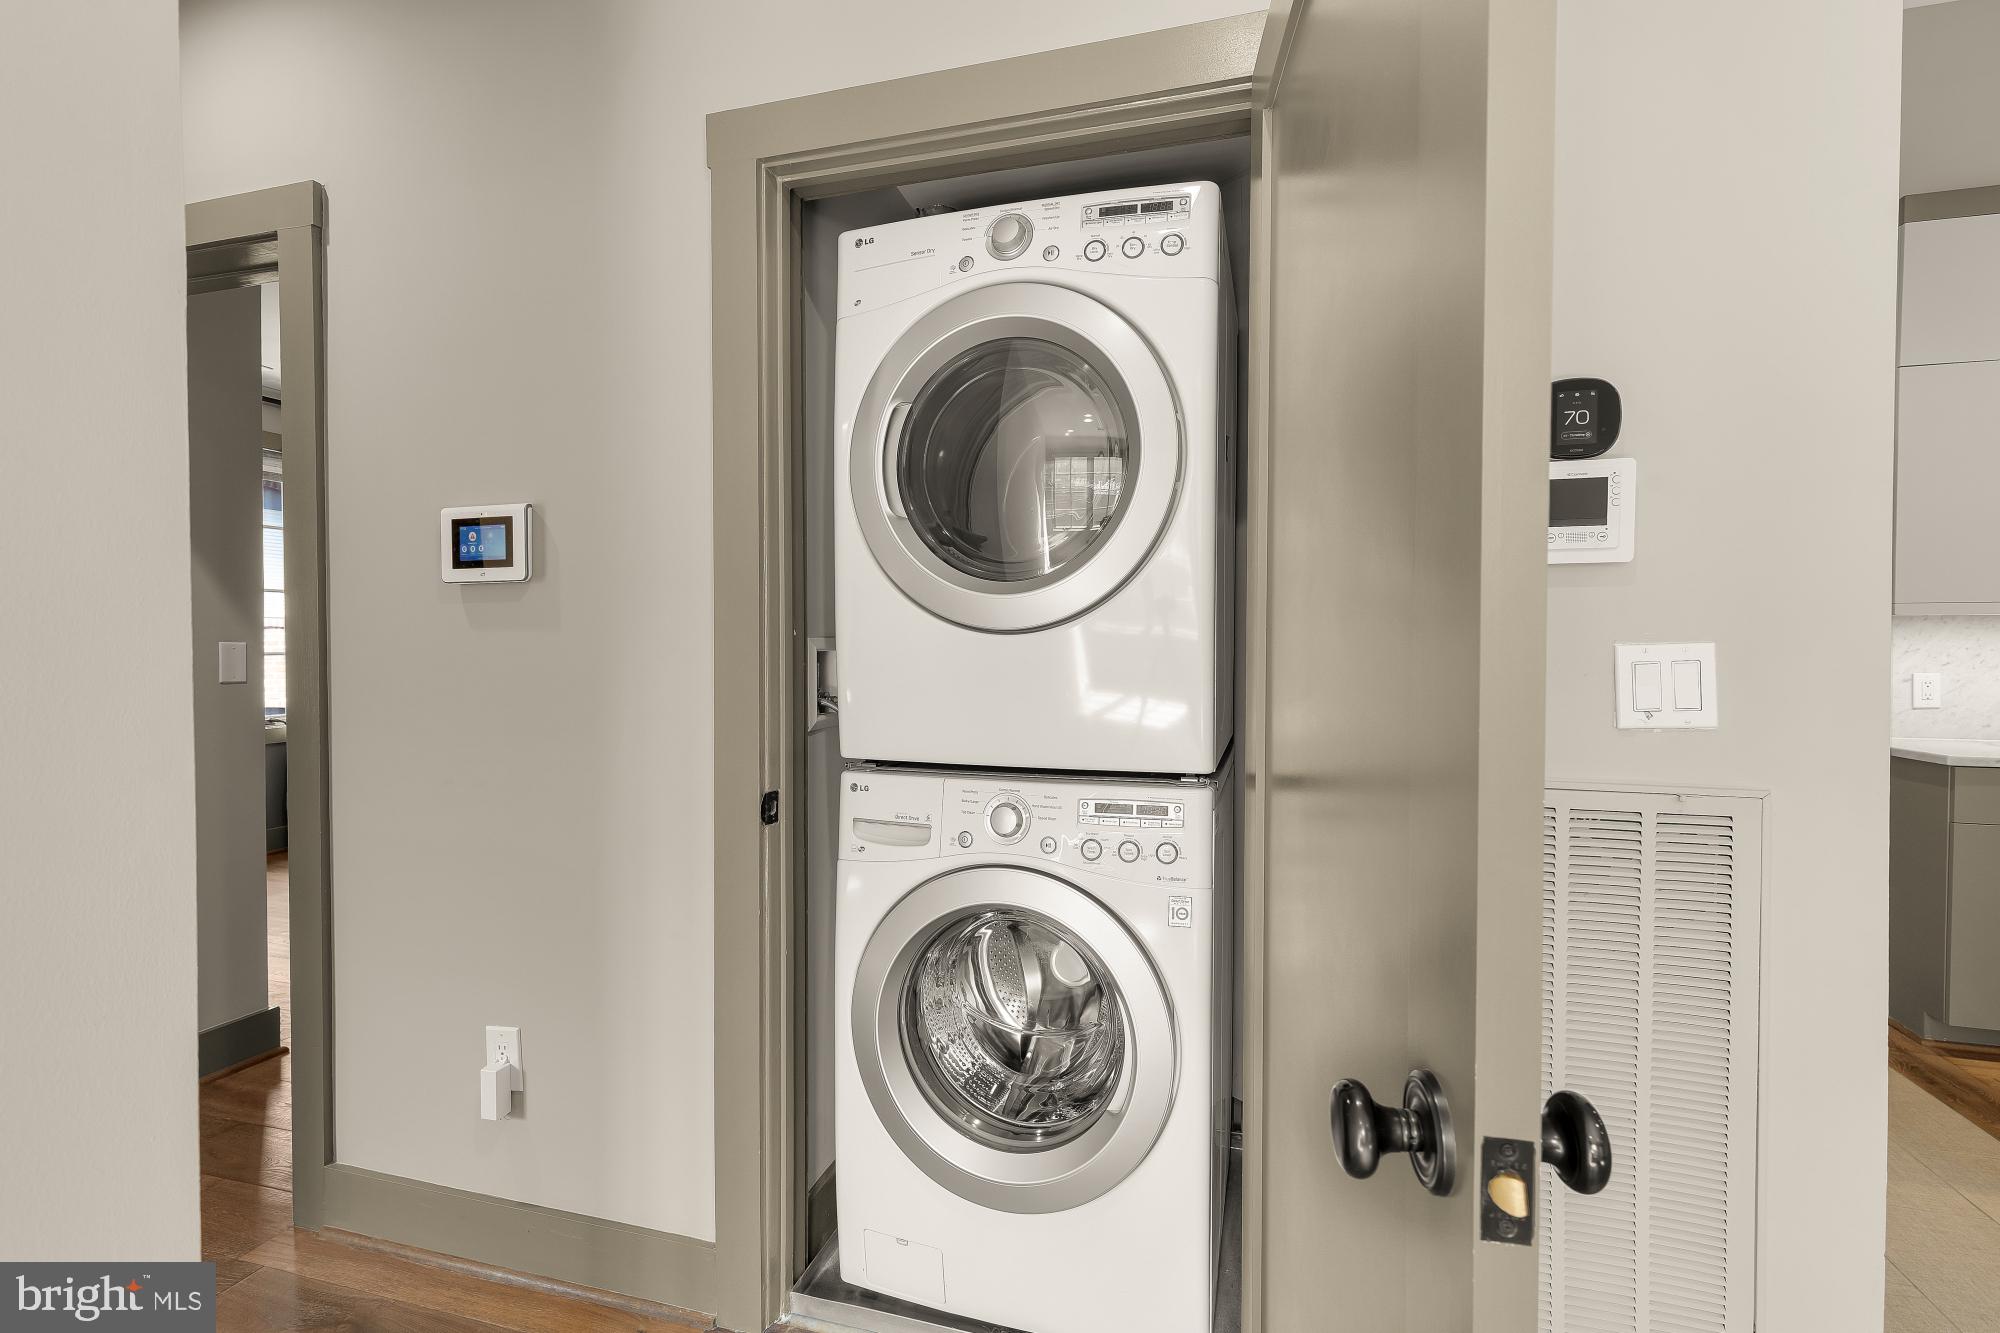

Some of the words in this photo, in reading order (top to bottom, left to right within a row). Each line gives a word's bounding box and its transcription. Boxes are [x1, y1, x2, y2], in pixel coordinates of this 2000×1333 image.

[864, 237, 875, 245] LG
[1563, 409, 1590, 426] 70
[859, 784, 870, 792] LG
